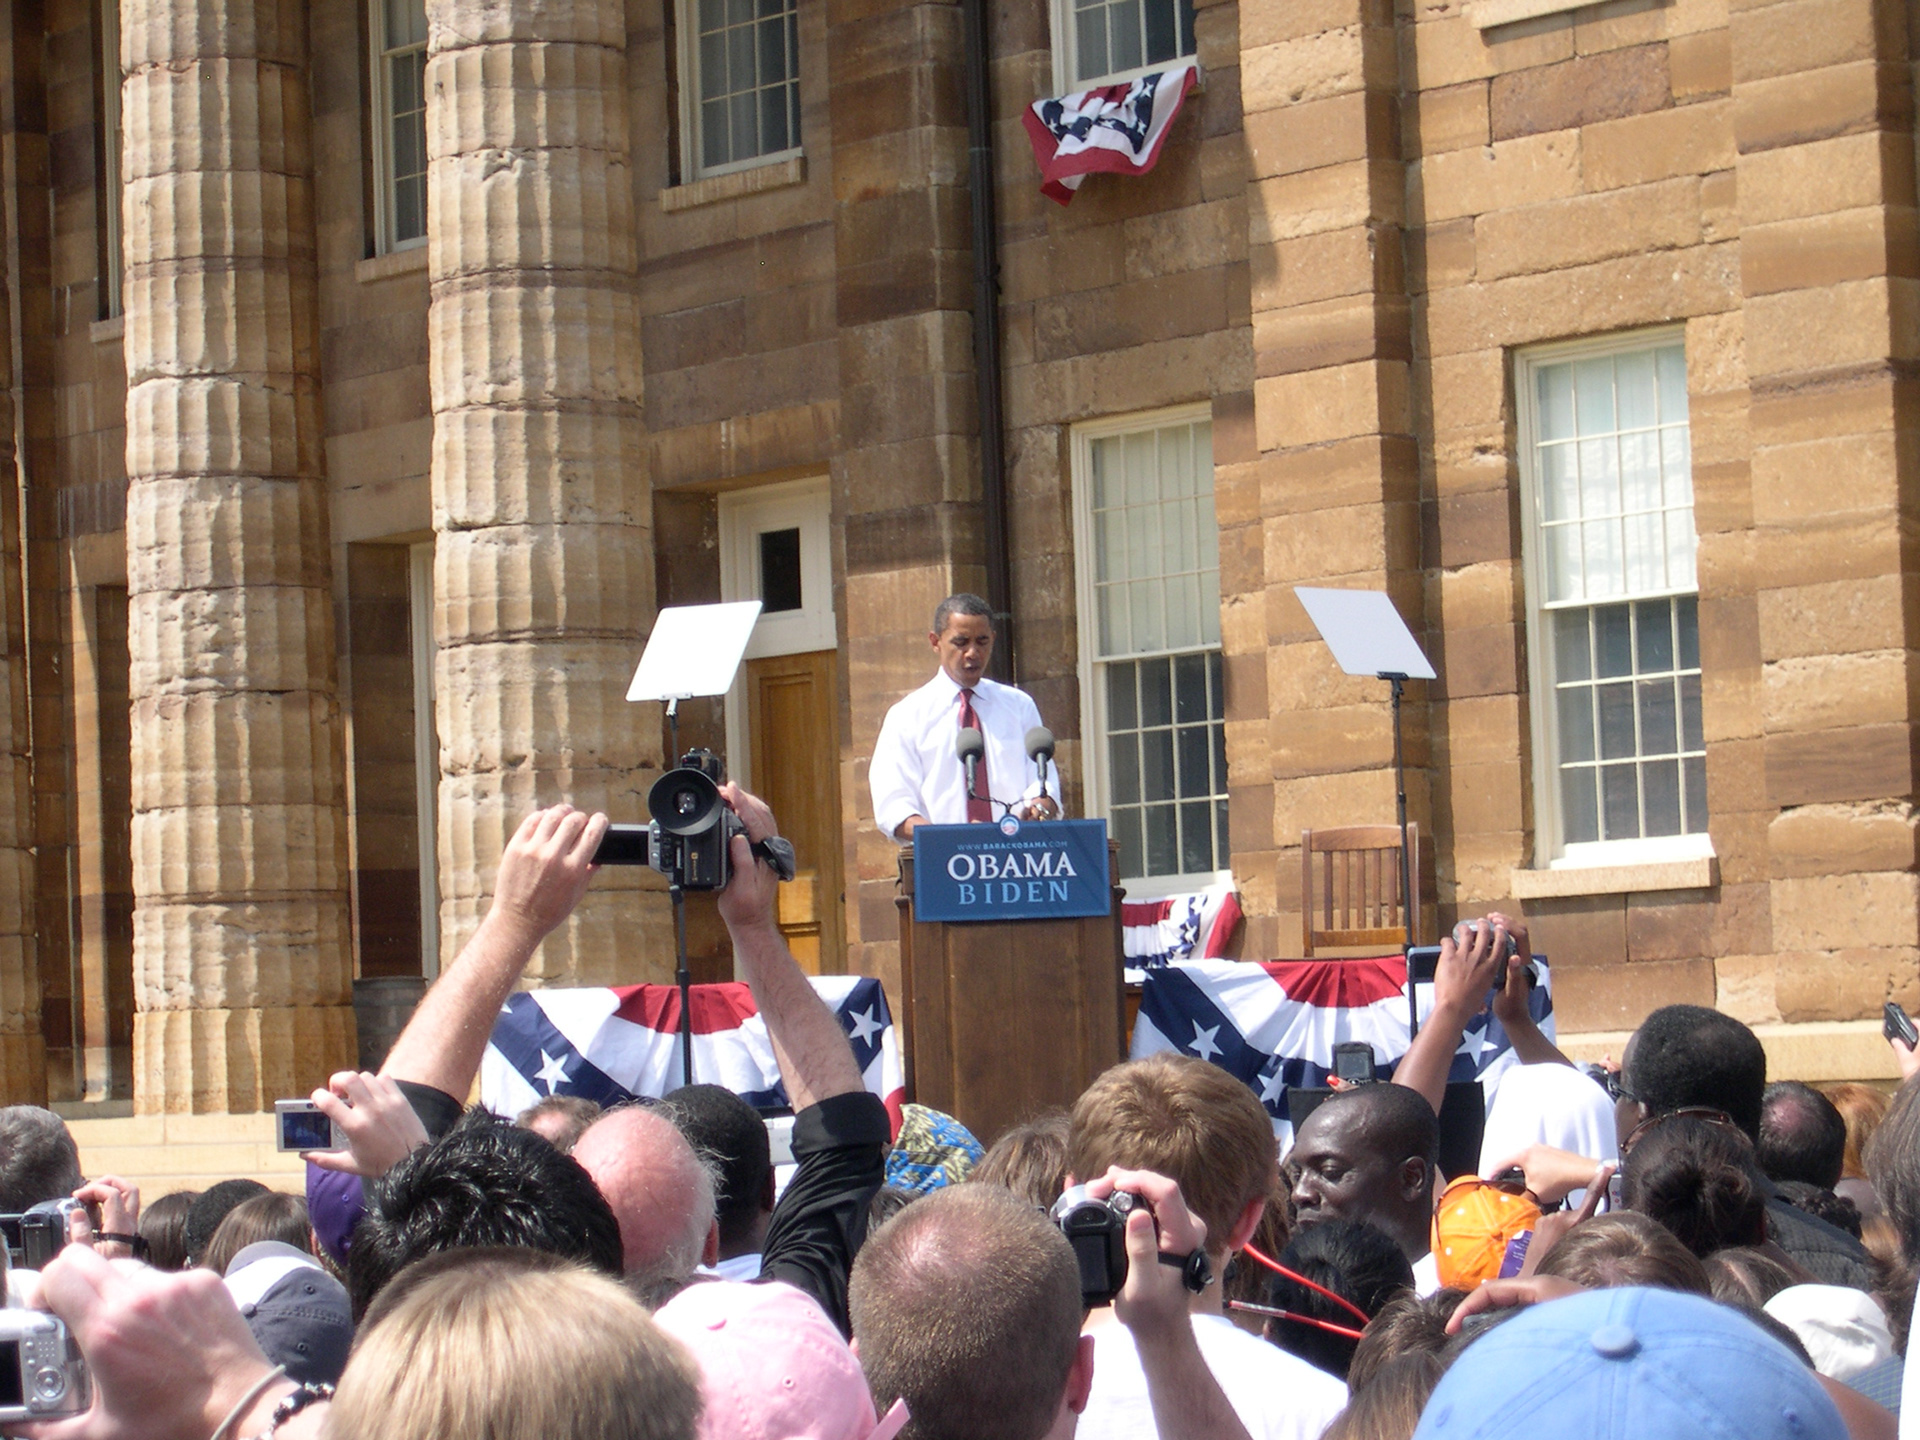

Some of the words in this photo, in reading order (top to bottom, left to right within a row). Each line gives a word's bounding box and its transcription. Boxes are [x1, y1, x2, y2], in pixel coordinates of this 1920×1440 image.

[957, 841, 1068, 850] WWW.BARACKOBAMA.COM
[947, 852, 1077, 881] OBAMA
[958, 881, 1068, 904] BIDEN
